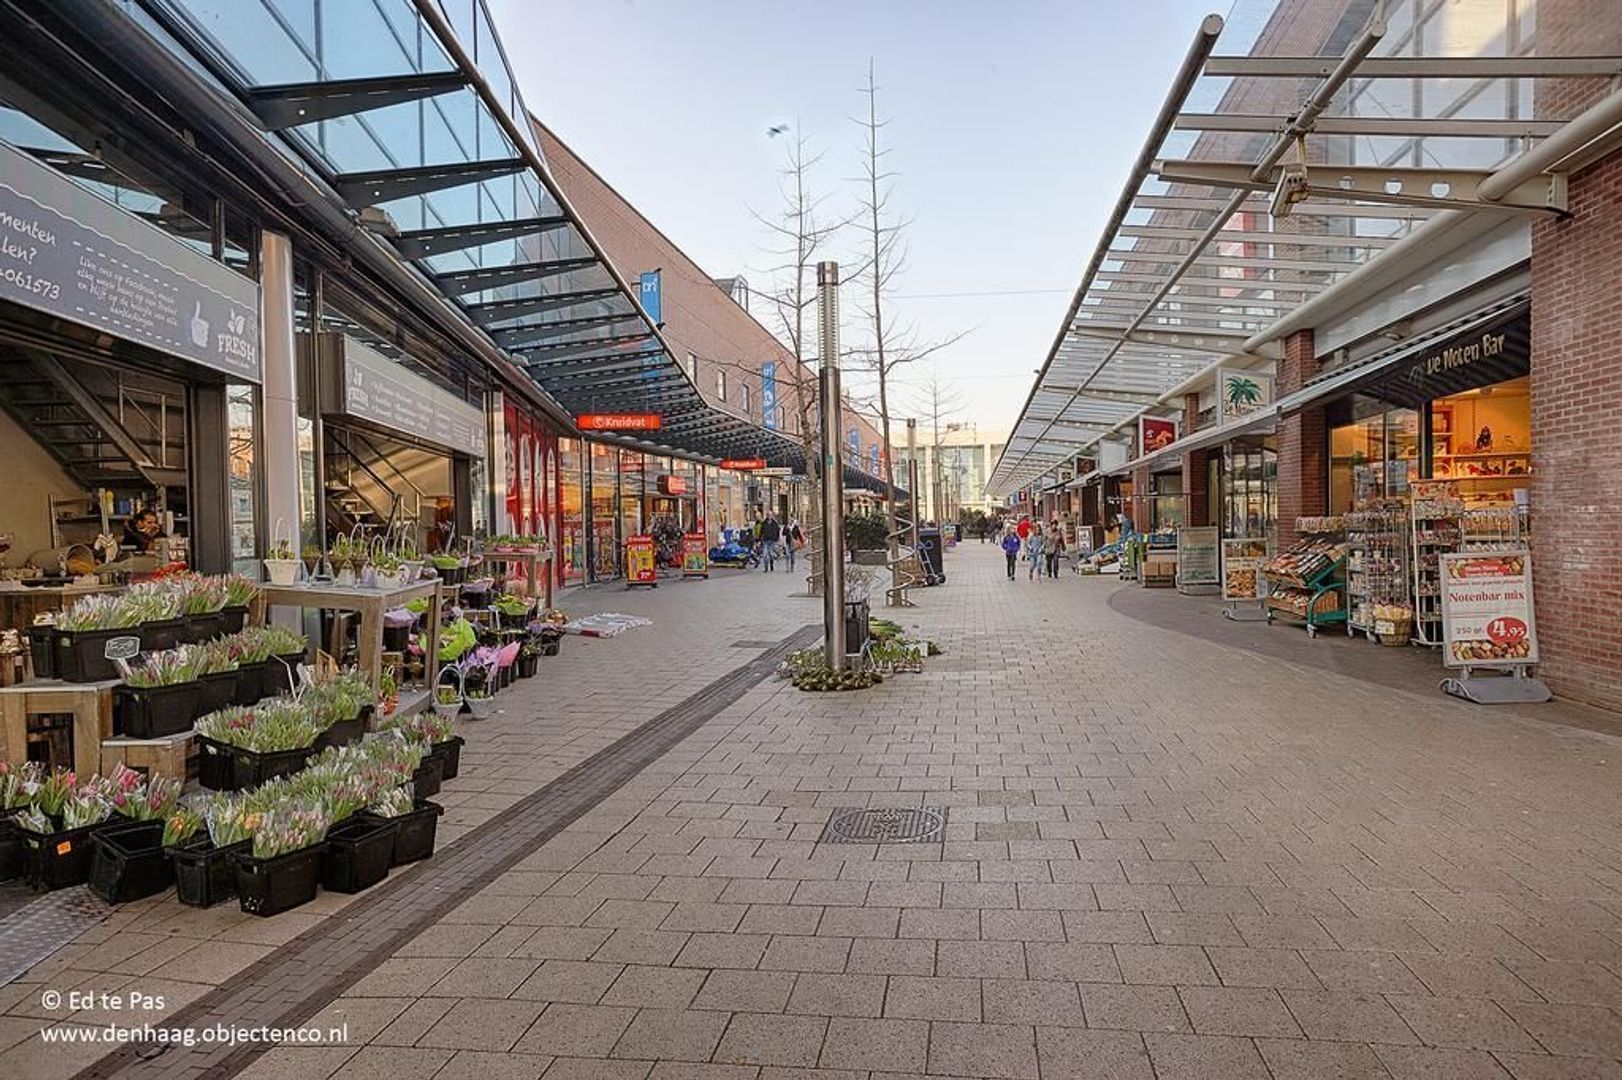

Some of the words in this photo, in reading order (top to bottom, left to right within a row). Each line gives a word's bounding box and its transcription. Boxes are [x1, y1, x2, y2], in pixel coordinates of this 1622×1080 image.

[217, 334, 256, 366] FRESH
[1442, 343, 1479, 369] Noten
[1482, 333, 1505, 357] Bar
[1449, 590, 1501, 603] Notenbar
[1504, 589, 1525, 600] mix
